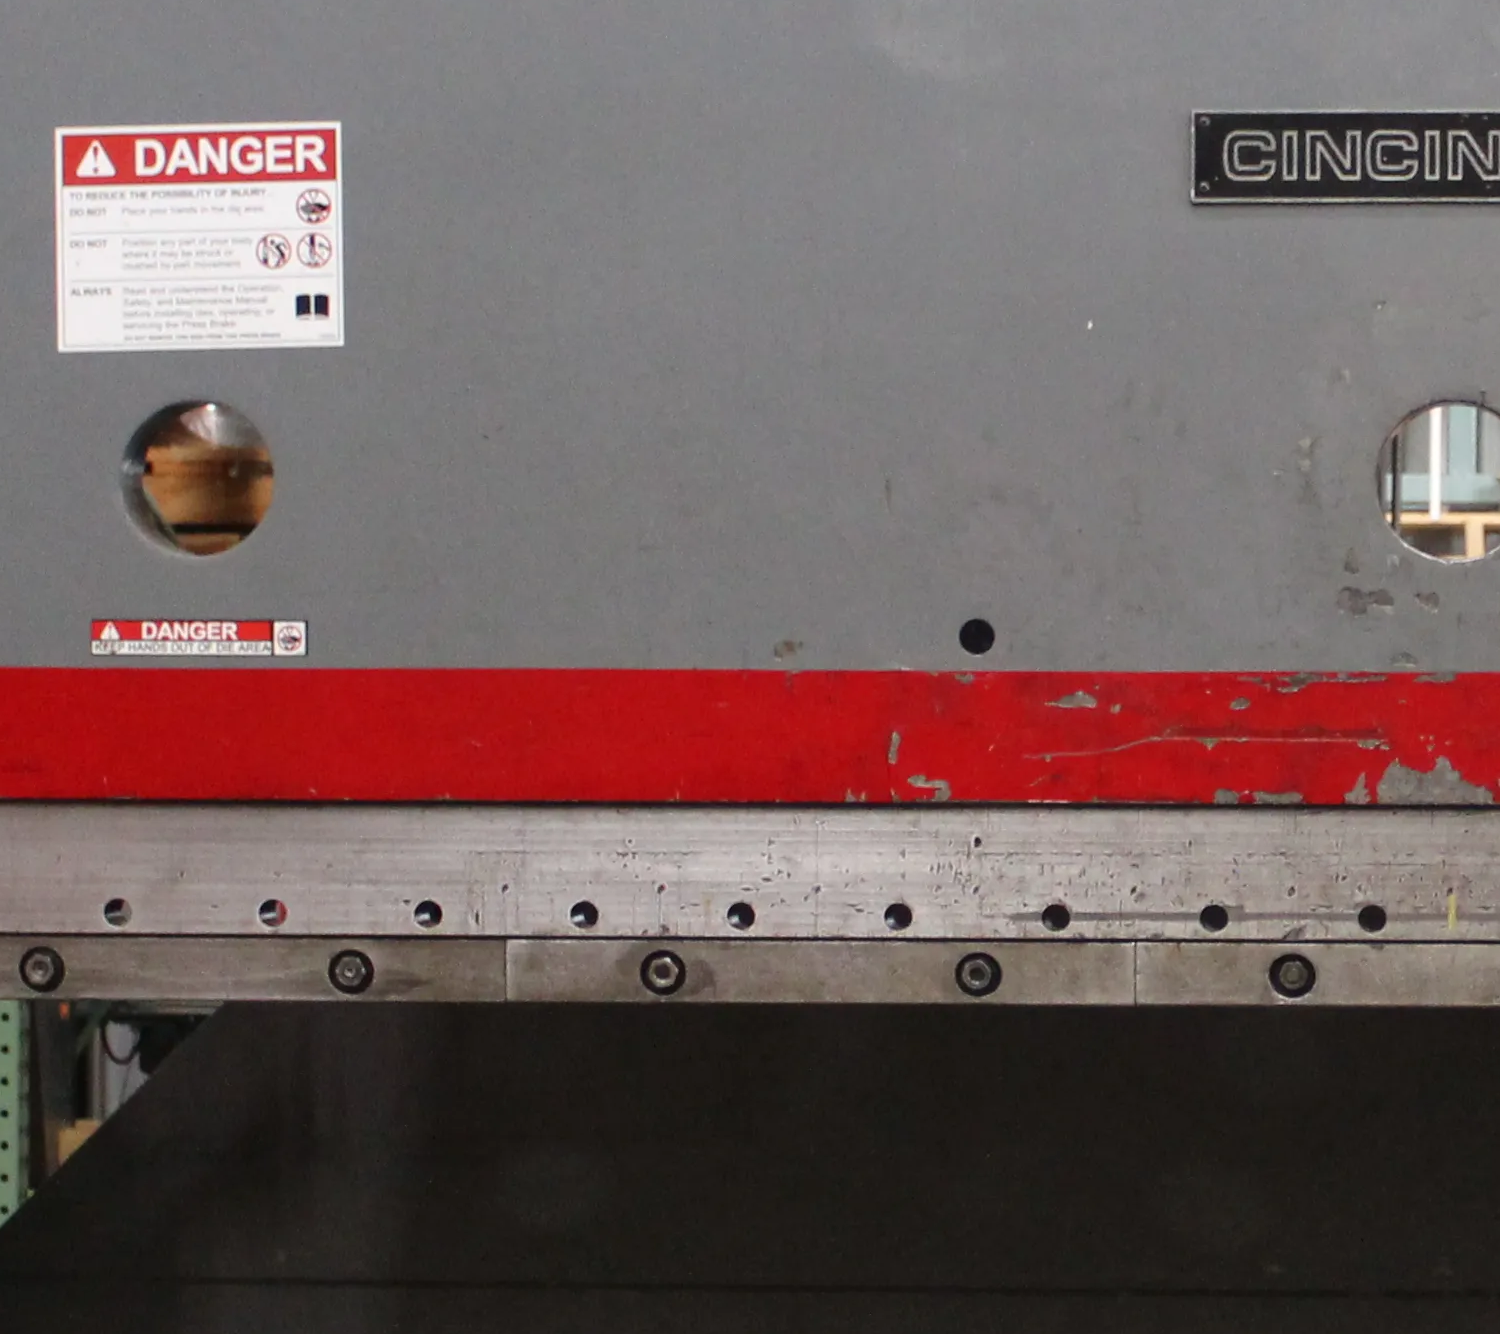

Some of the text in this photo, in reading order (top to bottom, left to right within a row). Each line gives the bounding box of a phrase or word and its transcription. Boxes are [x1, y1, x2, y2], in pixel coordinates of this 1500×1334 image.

[134, 134, 328, 177] DANGER
[141, 621, 238, 640] DANGER
[128, 641, 168, 652] HANDS
[171, 641, 196, 652] OUT
[198, 641, 214, 652] OF
[217, 641, 233, 652] DIE
[238, 641, 272, 652] AREA
